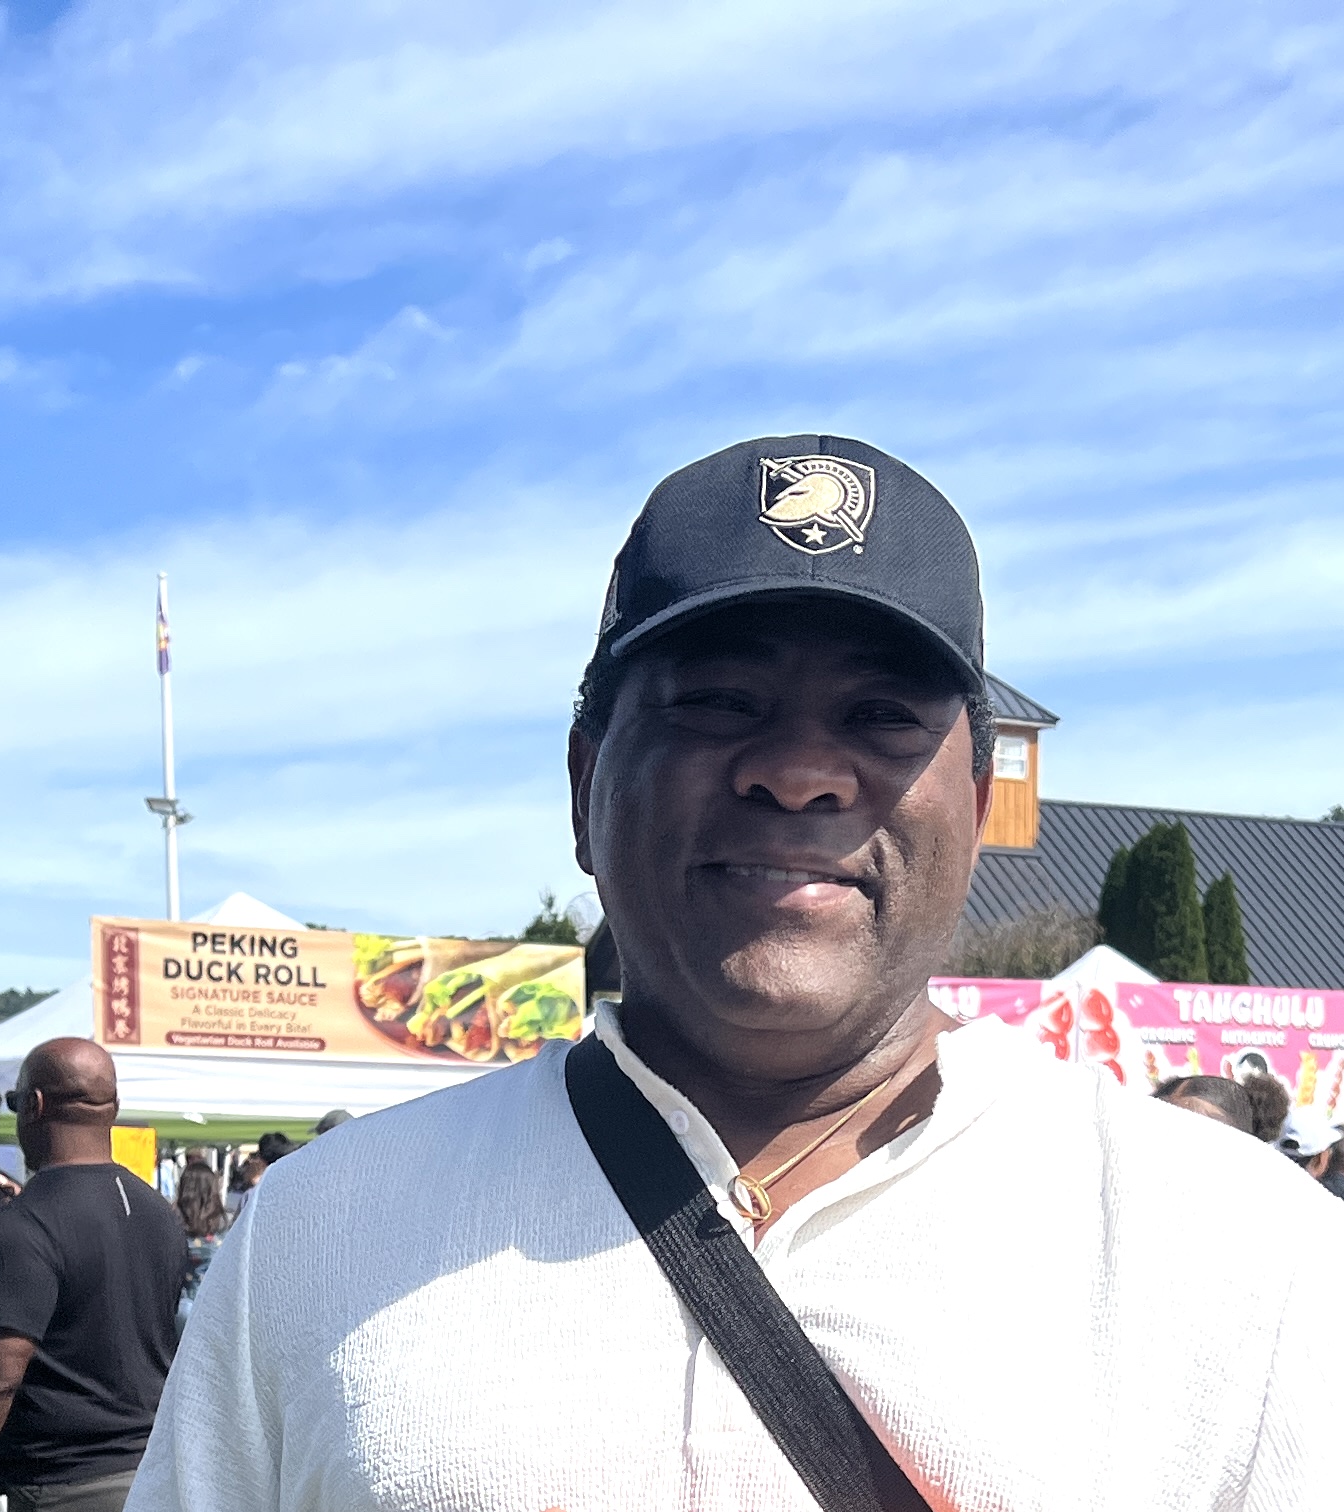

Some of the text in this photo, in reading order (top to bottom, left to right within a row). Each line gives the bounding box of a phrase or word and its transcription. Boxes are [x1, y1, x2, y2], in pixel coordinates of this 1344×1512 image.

[191, 932, 299, 958] PEKING
[163, 958, 327, 988] DUCK ROLL
[170, 986, 317, 1007] SIGNATURE SAUCE
[192, 1004, 297, 1021] A Classic Delicacy
[1173, 988, 1325, 1030] TANGHULU
[181, 1017, 232, 1030] Flavorful
[236, 1020, 246, 1030] in
[250, 1021, 281, 1034] Every
[171, 1032, 320, 1049] Vegetarian Duck Roll Available
